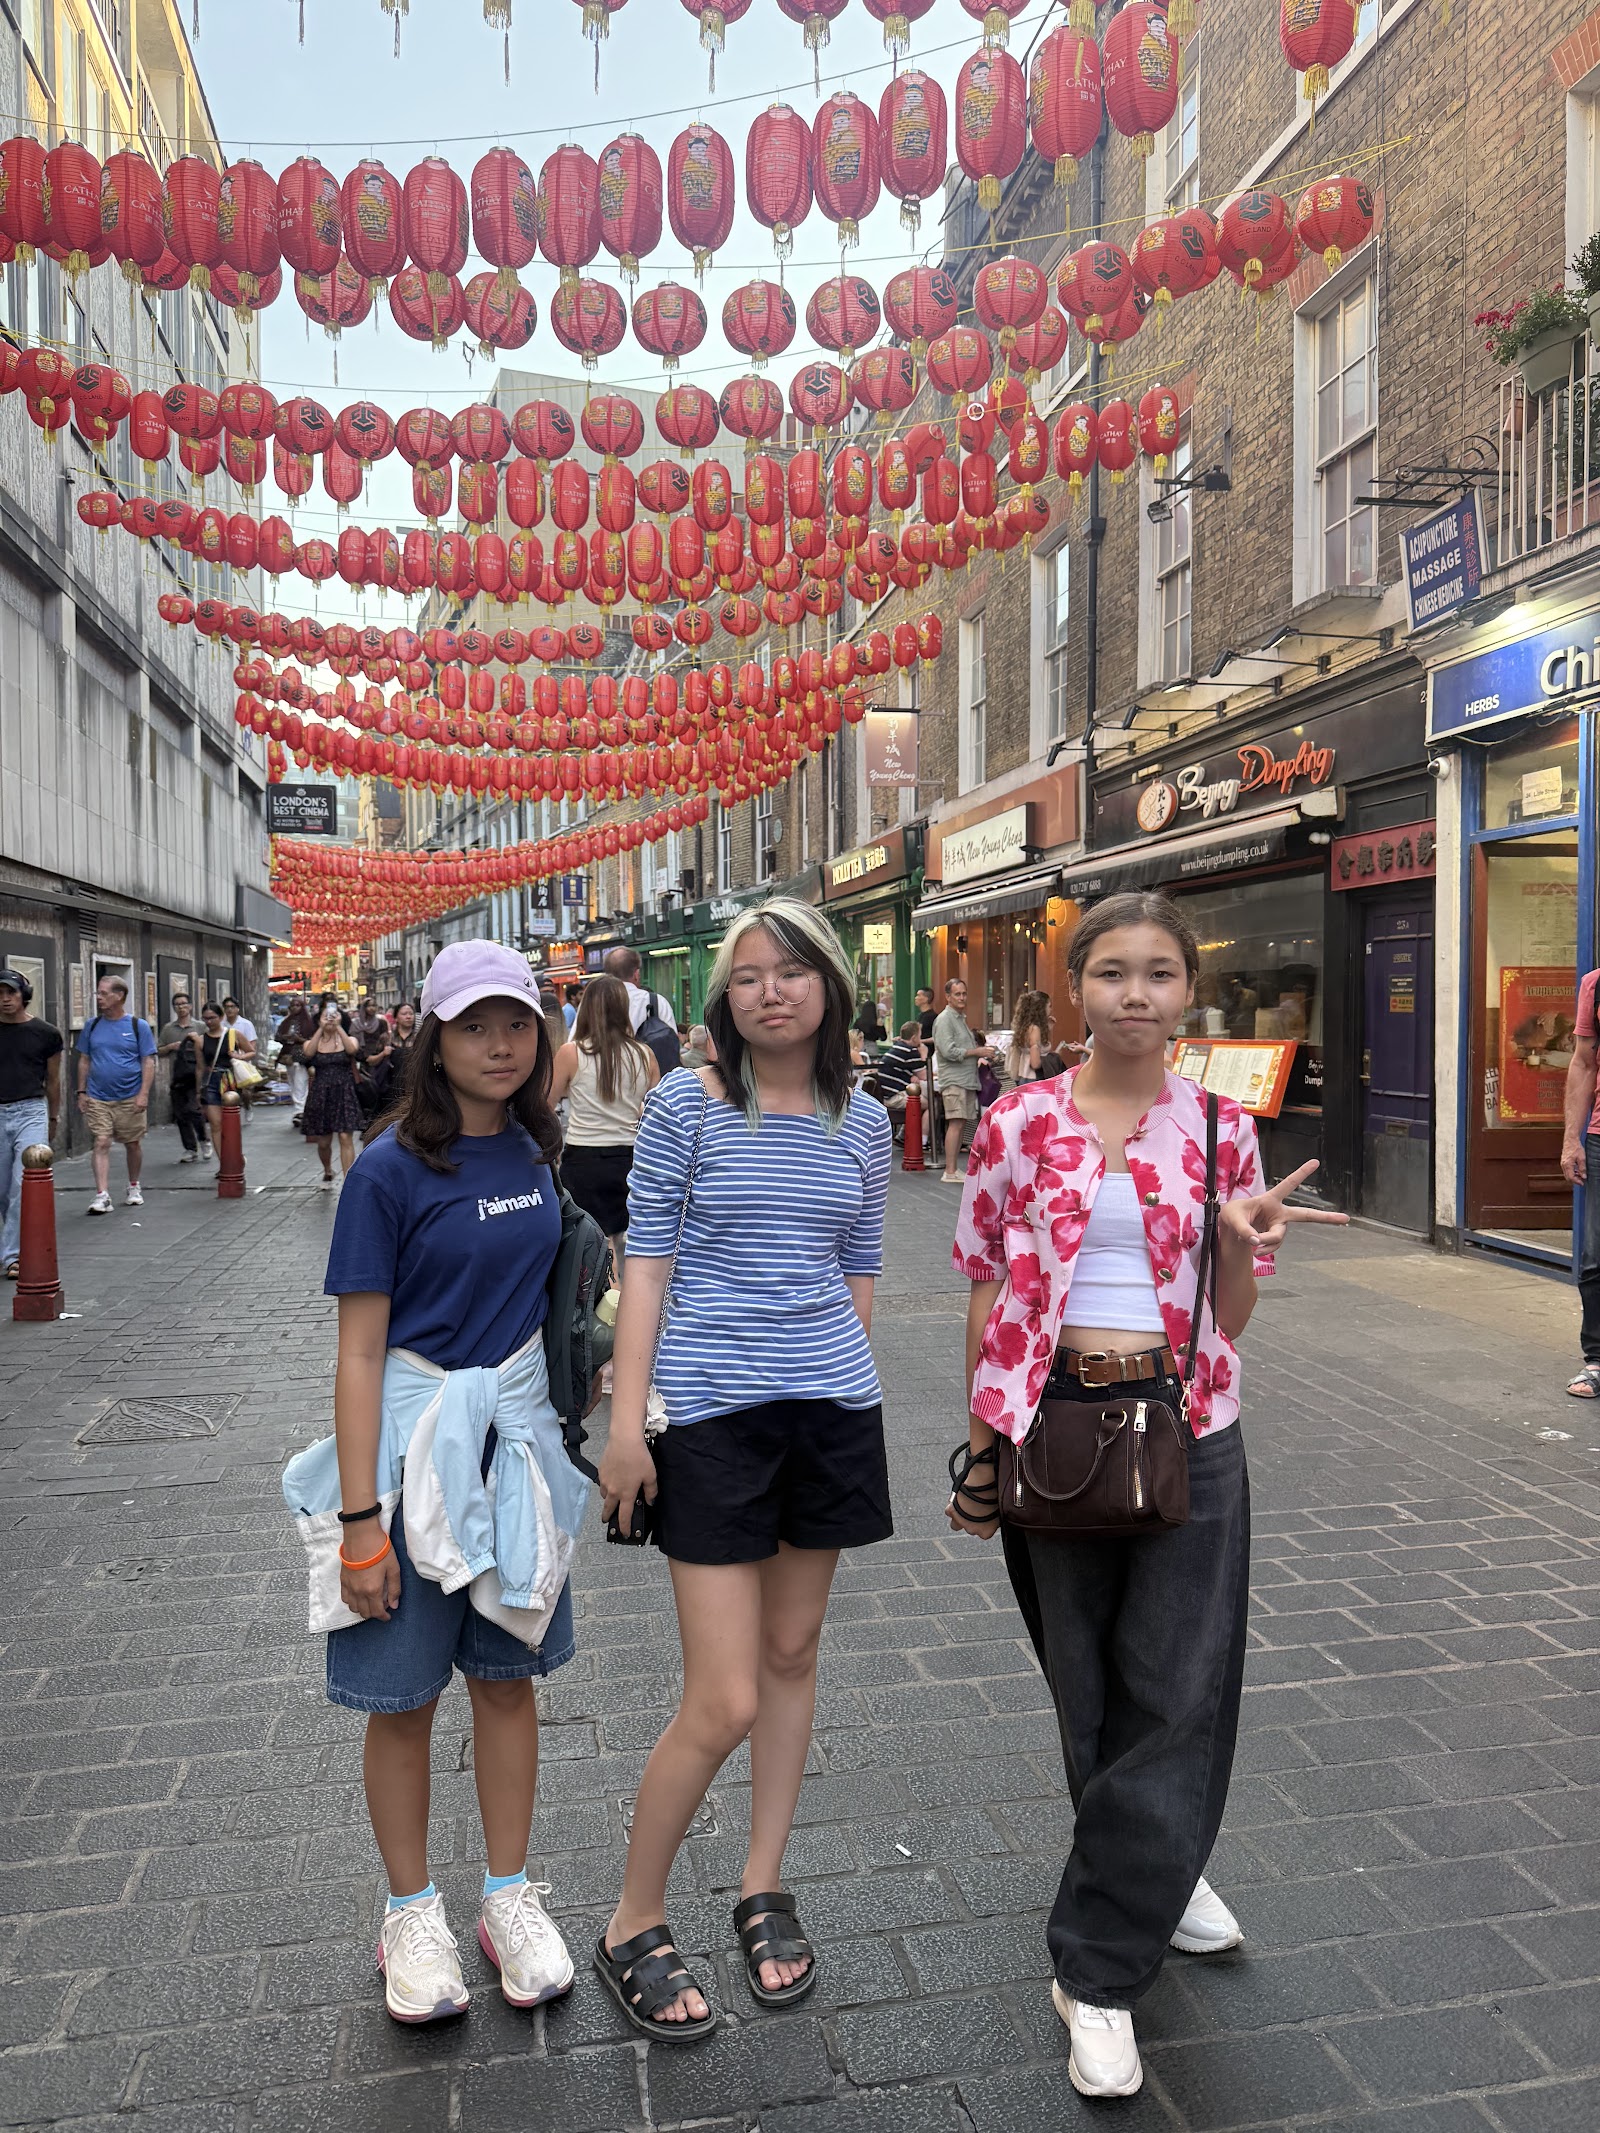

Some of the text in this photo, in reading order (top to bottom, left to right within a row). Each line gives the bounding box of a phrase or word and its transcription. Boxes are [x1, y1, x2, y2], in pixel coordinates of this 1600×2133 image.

[1066, 77, 1100, 93] CATHA
[64, 185, 100, 202] CATHA
[138, 420, 166, 430] CATHAY
[1100, 430, 1124, 438] CATHAY
[1409, 513, 1459, 563] ACUPUNCTURE
[1412, 548, 1462, 588] MASSAGE
[1415, 576, 1464, 621] CHINESE MEDICINE
[1465, 694, 1500, 717] HERBS
[884, 758, 901, 768] New
[1177, 741, 1335, 818] Beijing Dumpling
[273, 796, 327, 807] LONDON'S
[273, 807, 329, 816] BEST CINEMA
[966, 841, 980, 862] New
[1181, 841, 1269, 872] www.beijingdumpling.co.uk
[1304, 1074, 1323, 1087] Dumpl
[477, 1188, 544, 1221] j'aimavi
